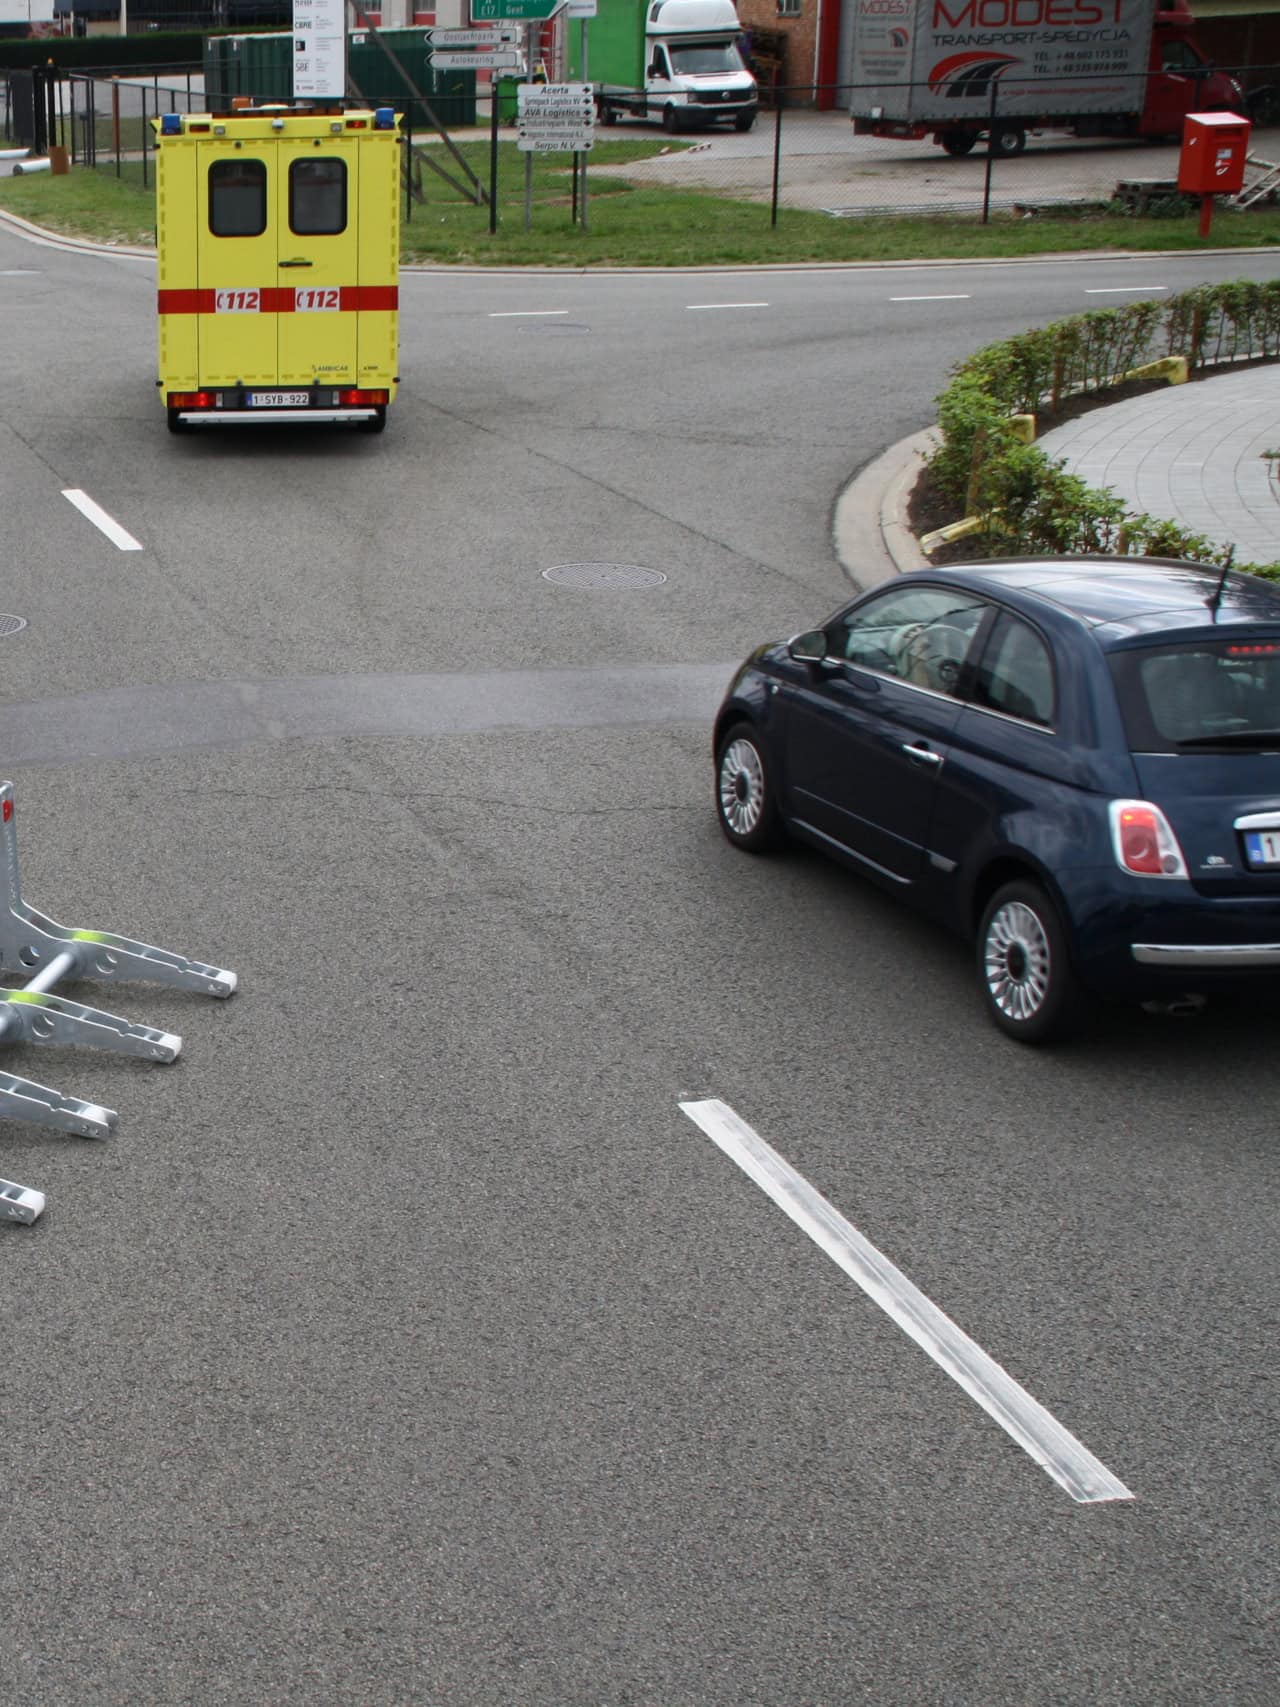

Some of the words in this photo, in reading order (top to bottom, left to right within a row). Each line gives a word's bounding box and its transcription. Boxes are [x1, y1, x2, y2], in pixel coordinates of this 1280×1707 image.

[481, 5, 496, 16] E17
[506, 4, 524, 15] Gent
[860, 0, 912, 14] MODEST
[932, 0, 1122, 28] MODEST
[450, 55, 495, 65] Autokeuring
[540, 85, 570, 95] Acerta
[543, 108, 581, 119] Logistics
[226, 291, 259, 310] 112
[306, 290, 338, 309] 112
